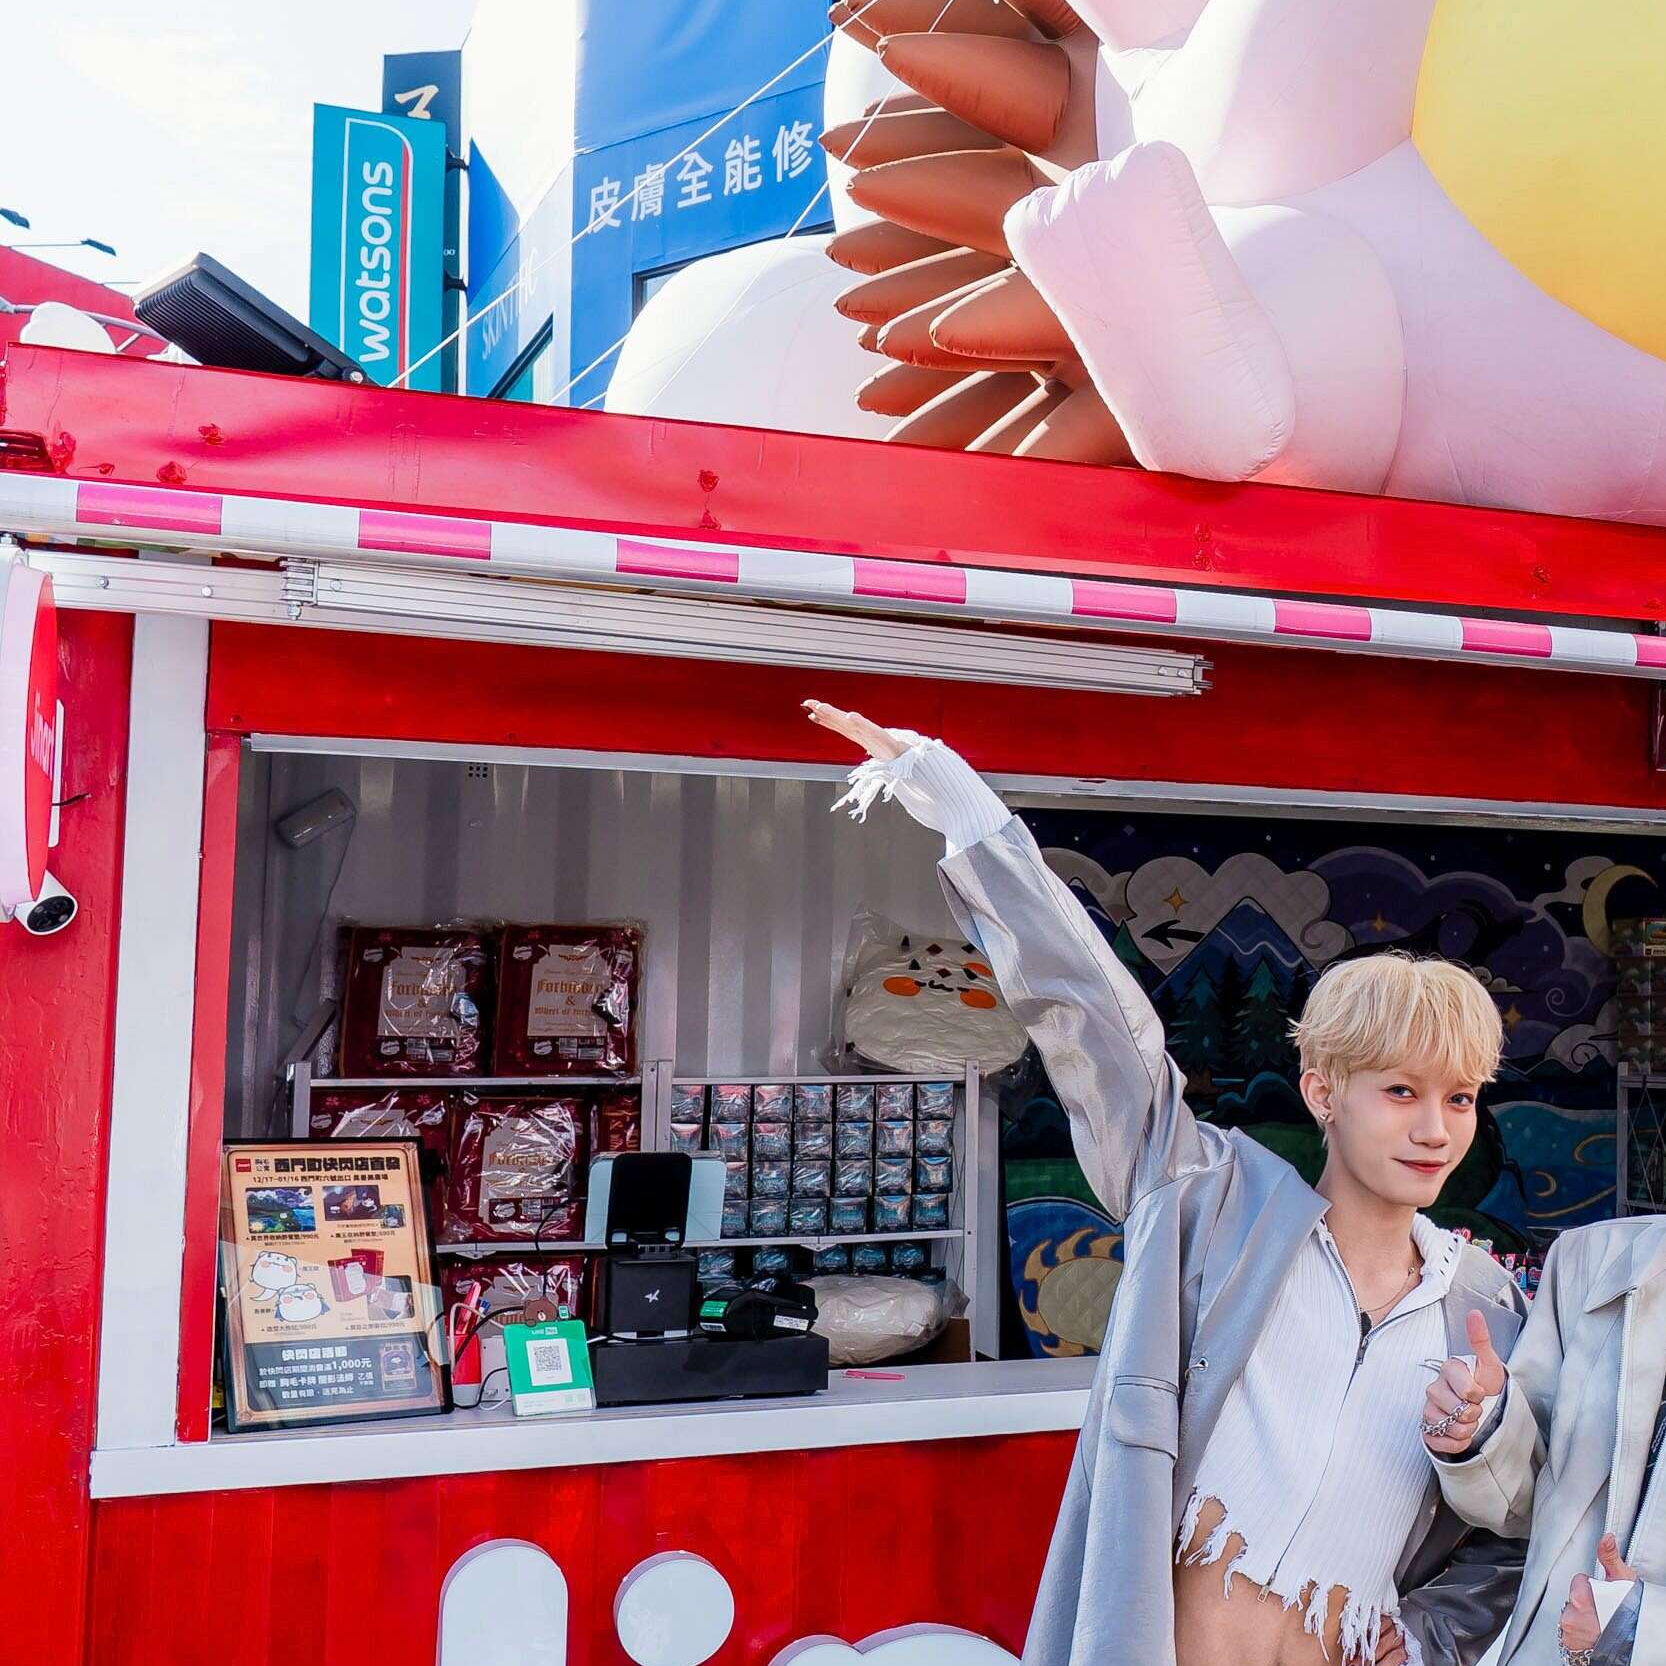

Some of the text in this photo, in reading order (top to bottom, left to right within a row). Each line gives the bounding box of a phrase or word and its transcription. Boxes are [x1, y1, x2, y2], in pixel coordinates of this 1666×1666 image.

[588, 120, 814, 235] 皮膚全能修
[355, 161, 393, 362] watsons
